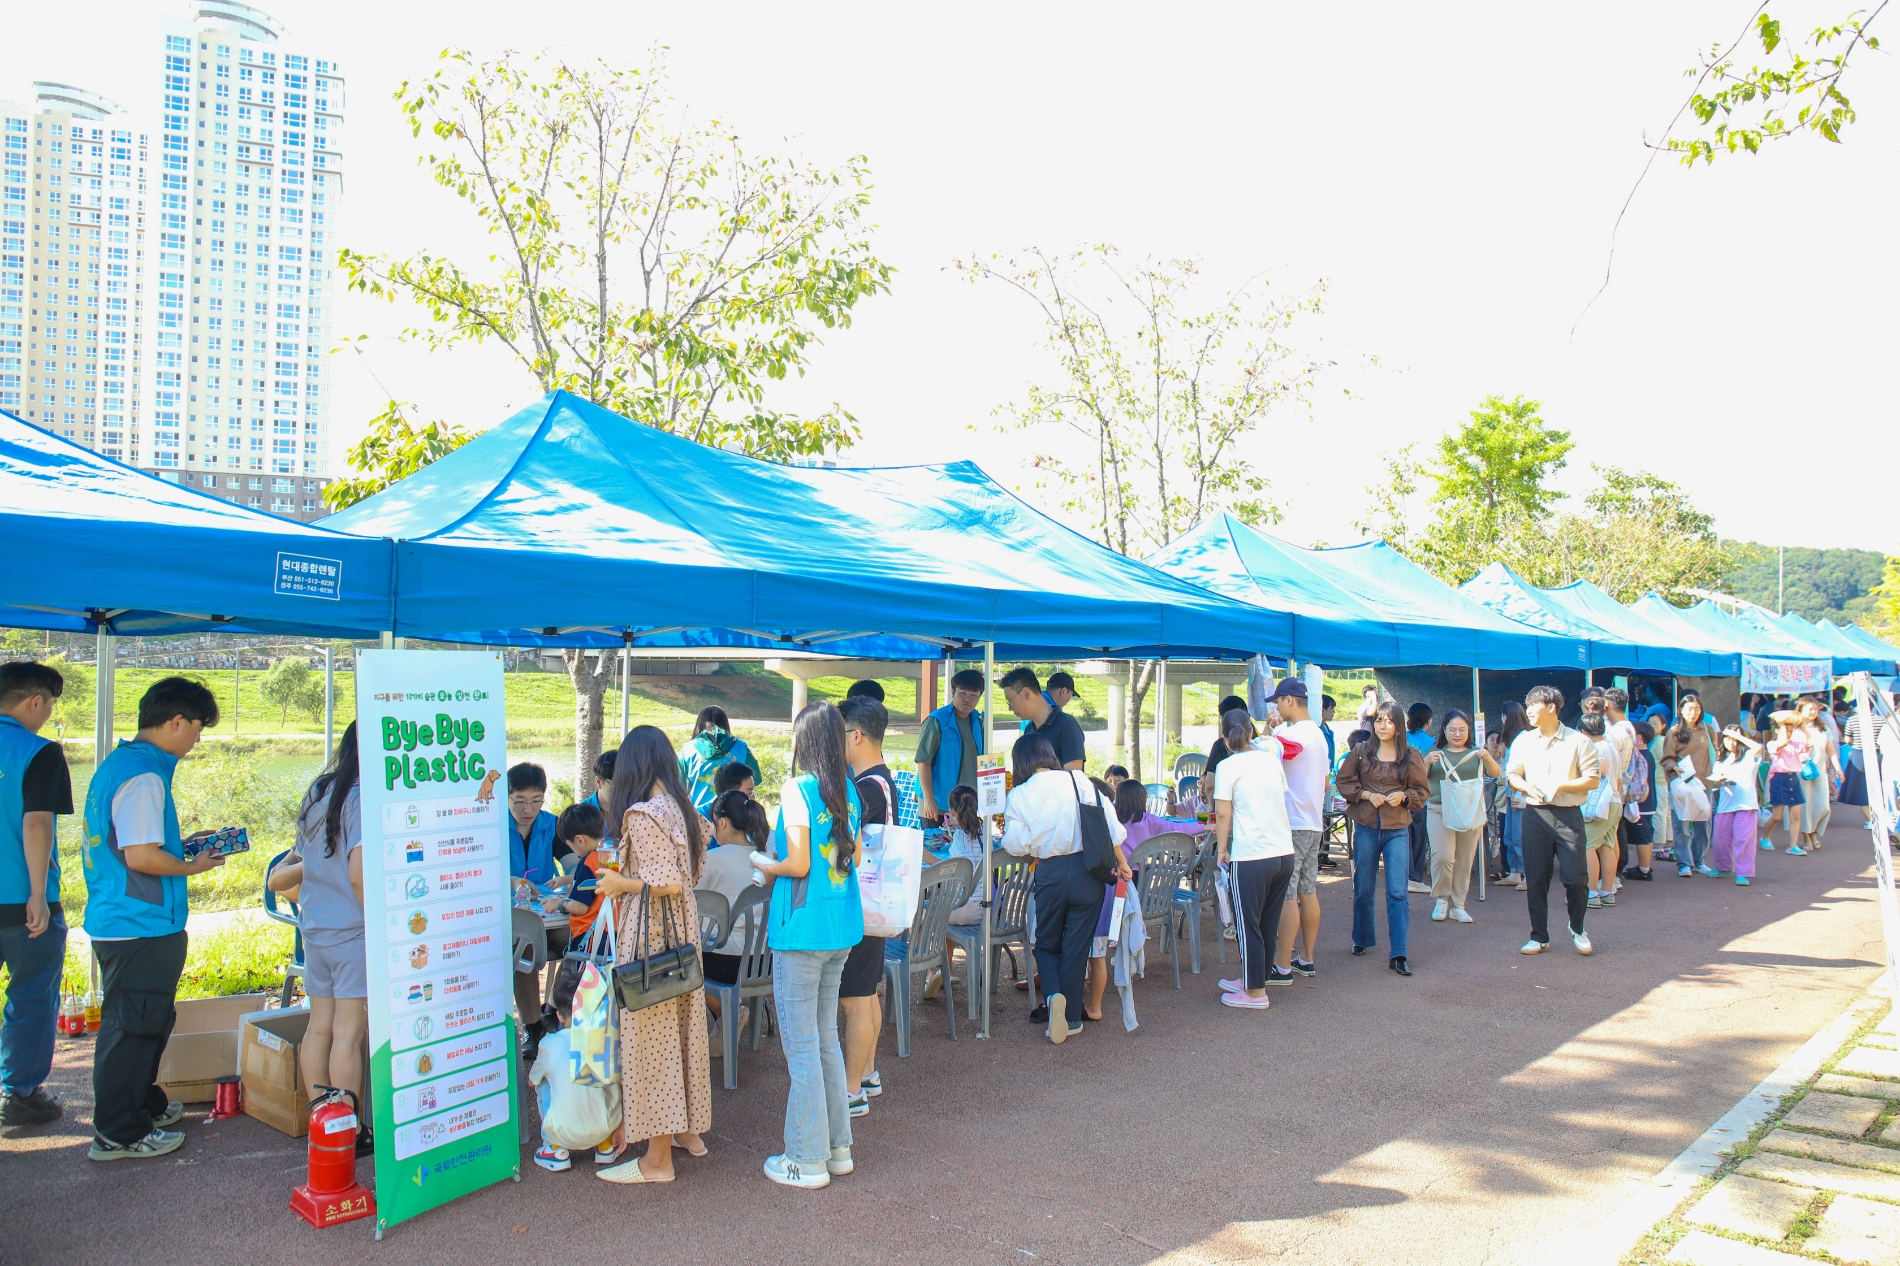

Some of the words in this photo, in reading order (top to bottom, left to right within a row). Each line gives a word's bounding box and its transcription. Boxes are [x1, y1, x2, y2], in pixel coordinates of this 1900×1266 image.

[282, 560, 336, 576] 현대종합렌탈
[374, 693, 390, 702] 지구를
[392, 692, 404, 702] 위한
[382, 716, 434, 752] Bye
[436, 713, 485, 748] Bye
[454, 807, 471, 815] 장바구니
[438, 838, 455, 847] 신선식품
[387, 843, 394, 855] 2
[467, 844, 484, 852] 사용하기
[456, 870, 472, 879] 플라스틱
[389, 879, 396, 891] 3
[450, 881, 464, 889] 줄이기
[392, 950, 399, 962] 5
[443, 950, 460, 960] 이용하기
[463, 980, 480, 990] 사용하기
[394, 986, 401, 998] 6
[460, 1015, 476, 1026] 플라스틱
[484, 1072, 500, 1082] 이용하기
[434, 1144, 492, 1173] 국토안전관리원
[326, 1196, 367, 1216] 소화기
